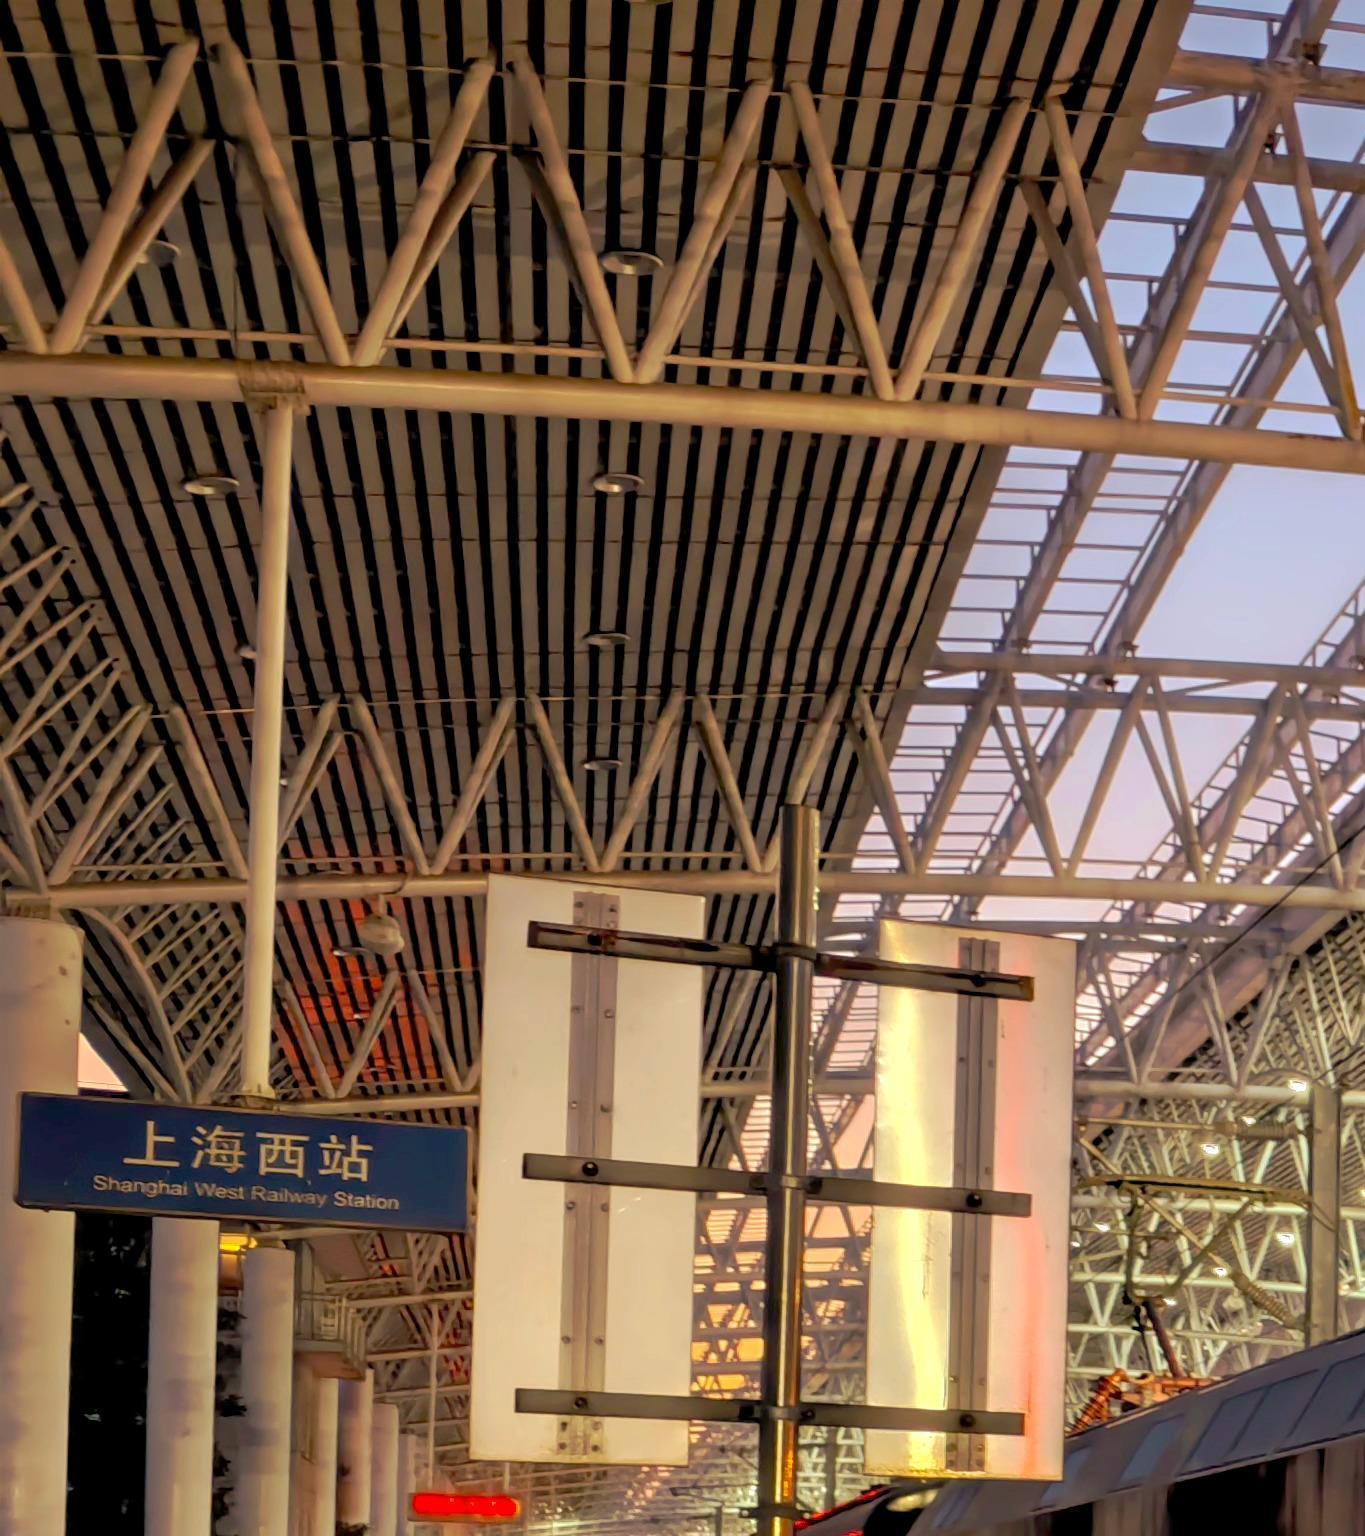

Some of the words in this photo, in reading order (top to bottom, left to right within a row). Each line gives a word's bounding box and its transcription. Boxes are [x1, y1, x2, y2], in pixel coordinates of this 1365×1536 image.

[122, 1119, 375, 1183] 上海西站
[92, 1174, 188, 1198] Shanghai
[194, 1182, 245, 1202] West
[251, 1185, 327, 1209] Railway
[333, 1190, 400, 1211] Station
